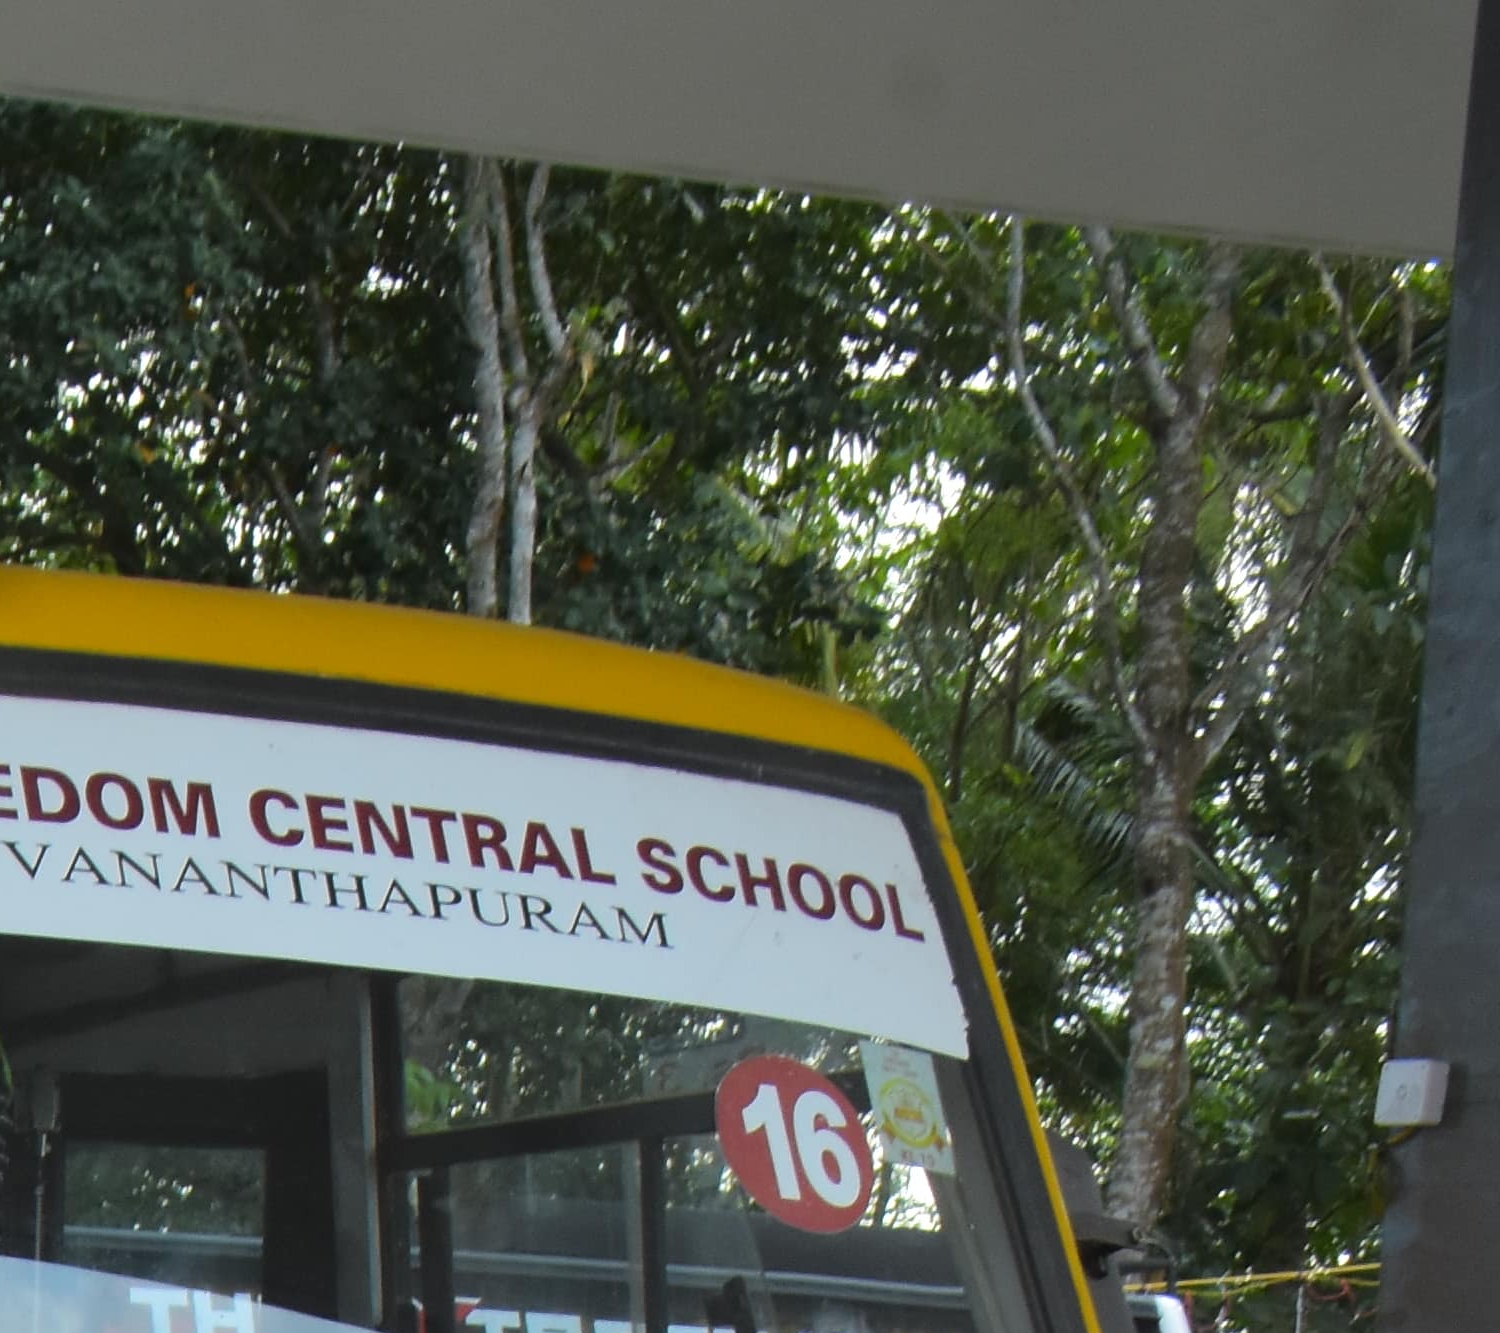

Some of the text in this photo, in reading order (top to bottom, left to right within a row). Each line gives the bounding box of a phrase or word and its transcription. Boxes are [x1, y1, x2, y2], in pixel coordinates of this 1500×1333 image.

[250, 788, 617, 887] CENTRAL
[637, 837, 926, 943] SCHOOL
[741, 1082, 861, 1209] 16
